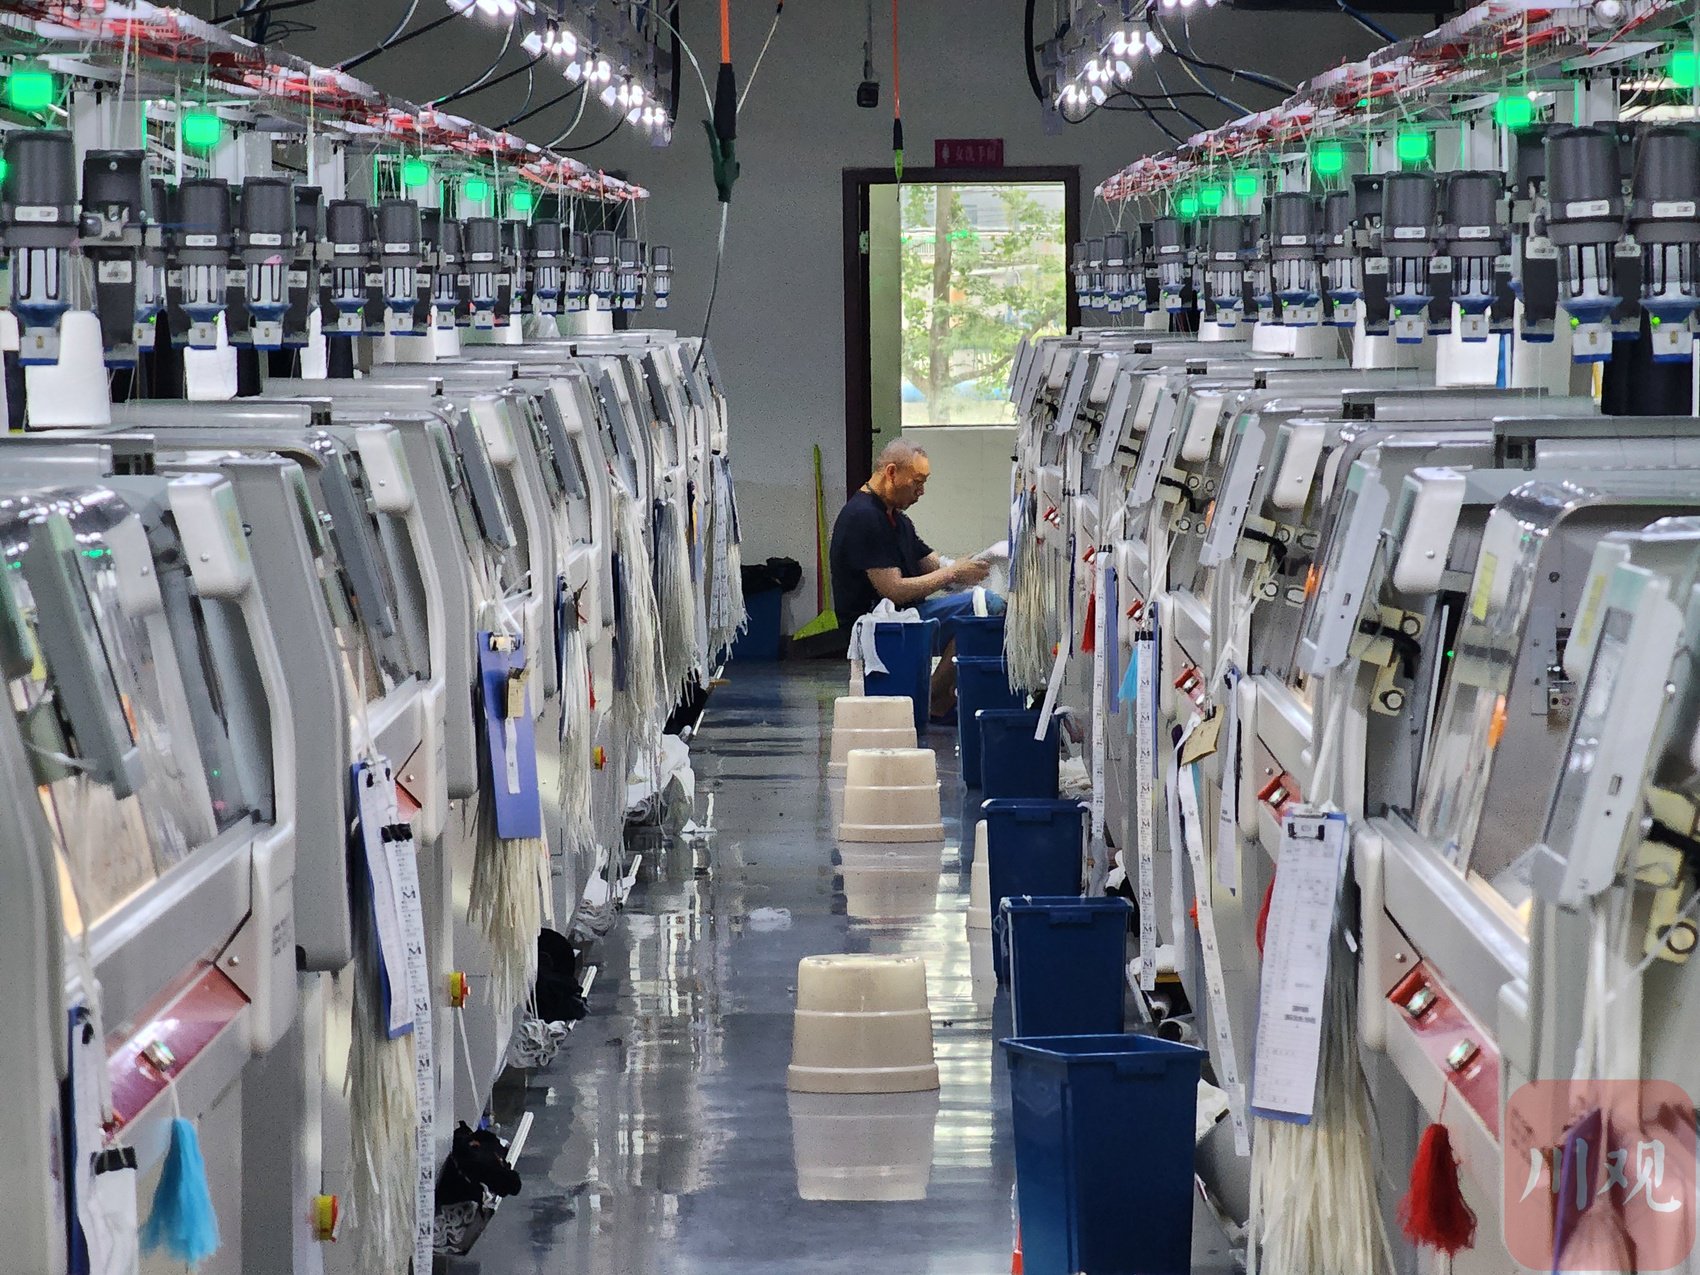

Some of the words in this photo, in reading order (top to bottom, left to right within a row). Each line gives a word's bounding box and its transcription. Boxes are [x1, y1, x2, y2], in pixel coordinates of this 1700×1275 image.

[402, 890, 416, 899] M
[408, 946, 422, 955] M
[416, 1003, 428, 1011] M
[418, 1059, 430, 1068] M
[421, 1115, 432, 1124] M
[421, 1171, 432, 1180] M
[419, 1226, 431, 1236] M
